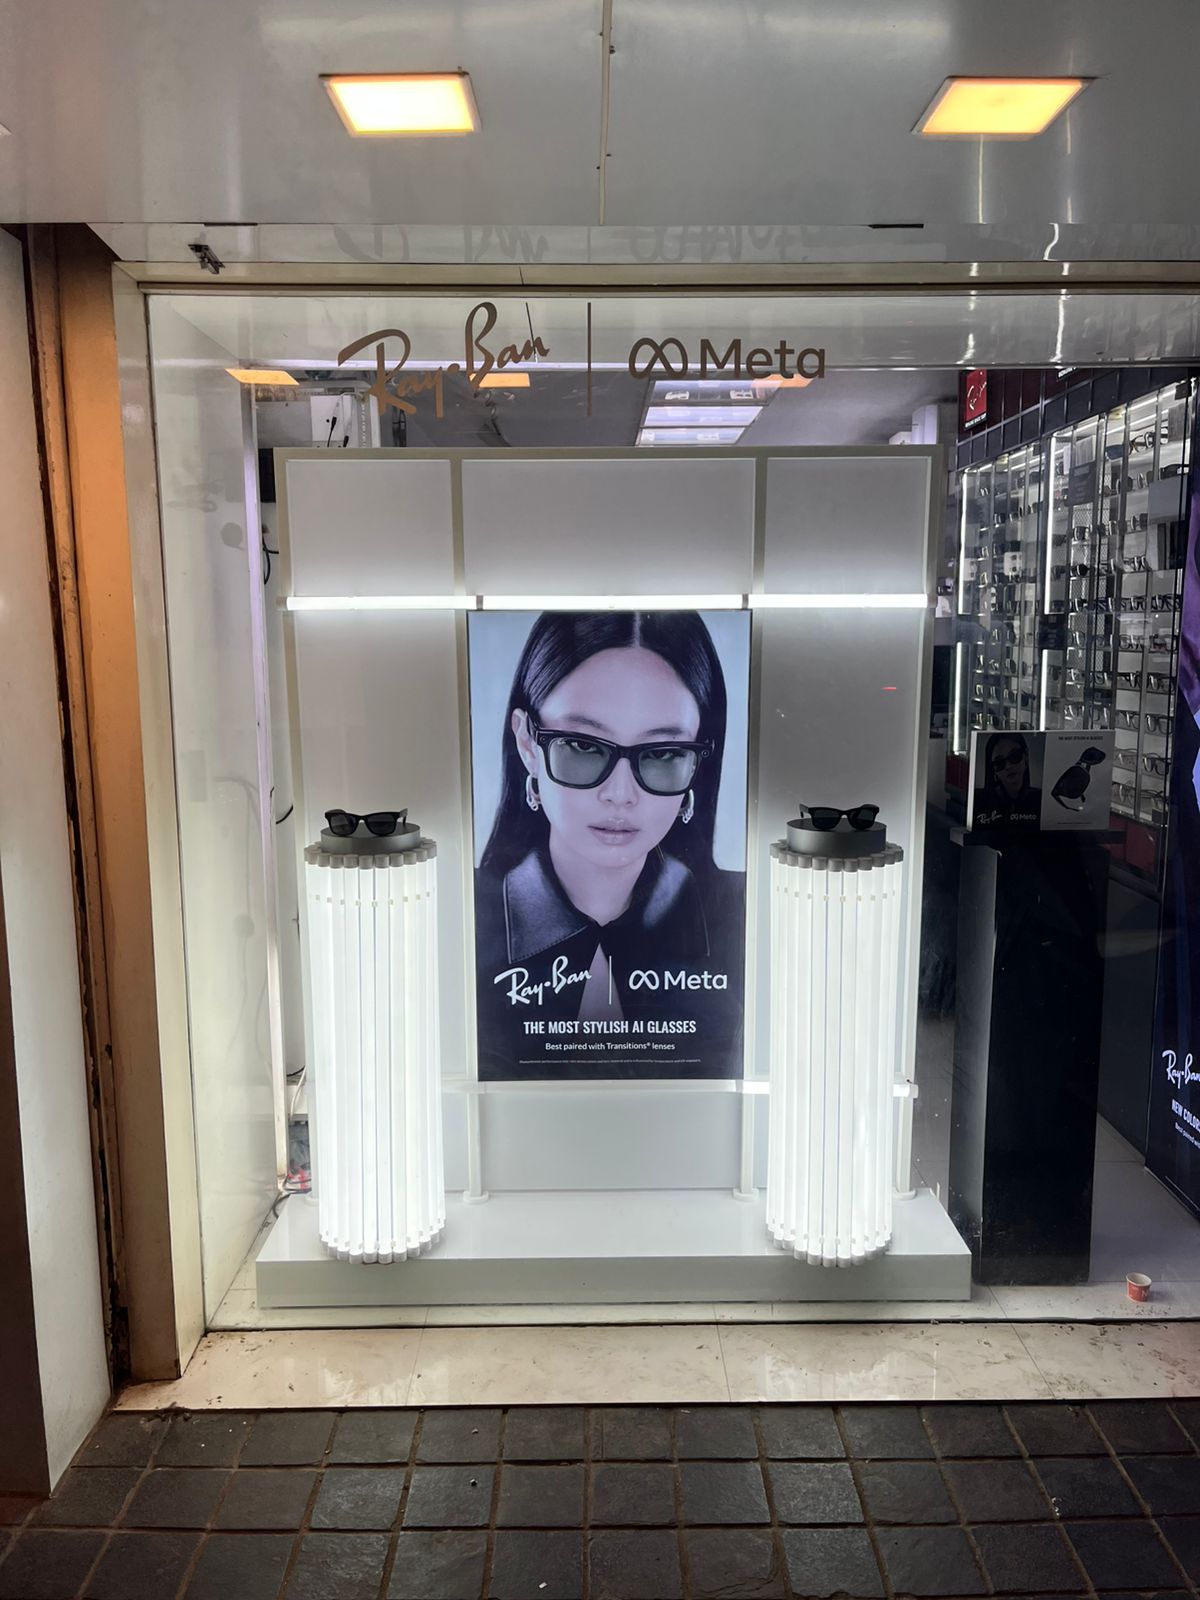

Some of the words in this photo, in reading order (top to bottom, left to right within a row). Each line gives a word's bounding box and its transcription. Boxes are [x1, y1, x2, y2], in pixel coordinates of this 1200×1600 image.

[337, 301, 551, 418] Ray-Ban
[700, 338, 826, 380] Meta
[493, 955, 593, 1006] Ray-Ban
[664, 970, 728, 990] Meta
[523, 1021, 546, 1034] THE
[548, 1021, 580, 1034] MOST
[582, 1020, 629, 1034] STYLISH
[631, 1020, 645, 1033] AI
[647, 1020, 697, 1034] GLASSES
[545, 1042, 563, 1050] Best
[563, 1042, 588, 1052] paired
[588, 1042, 606, 1050] with
[651, 1042, 676, 1050] lenses
[1172, 1099, 1183, 1117] NEW
